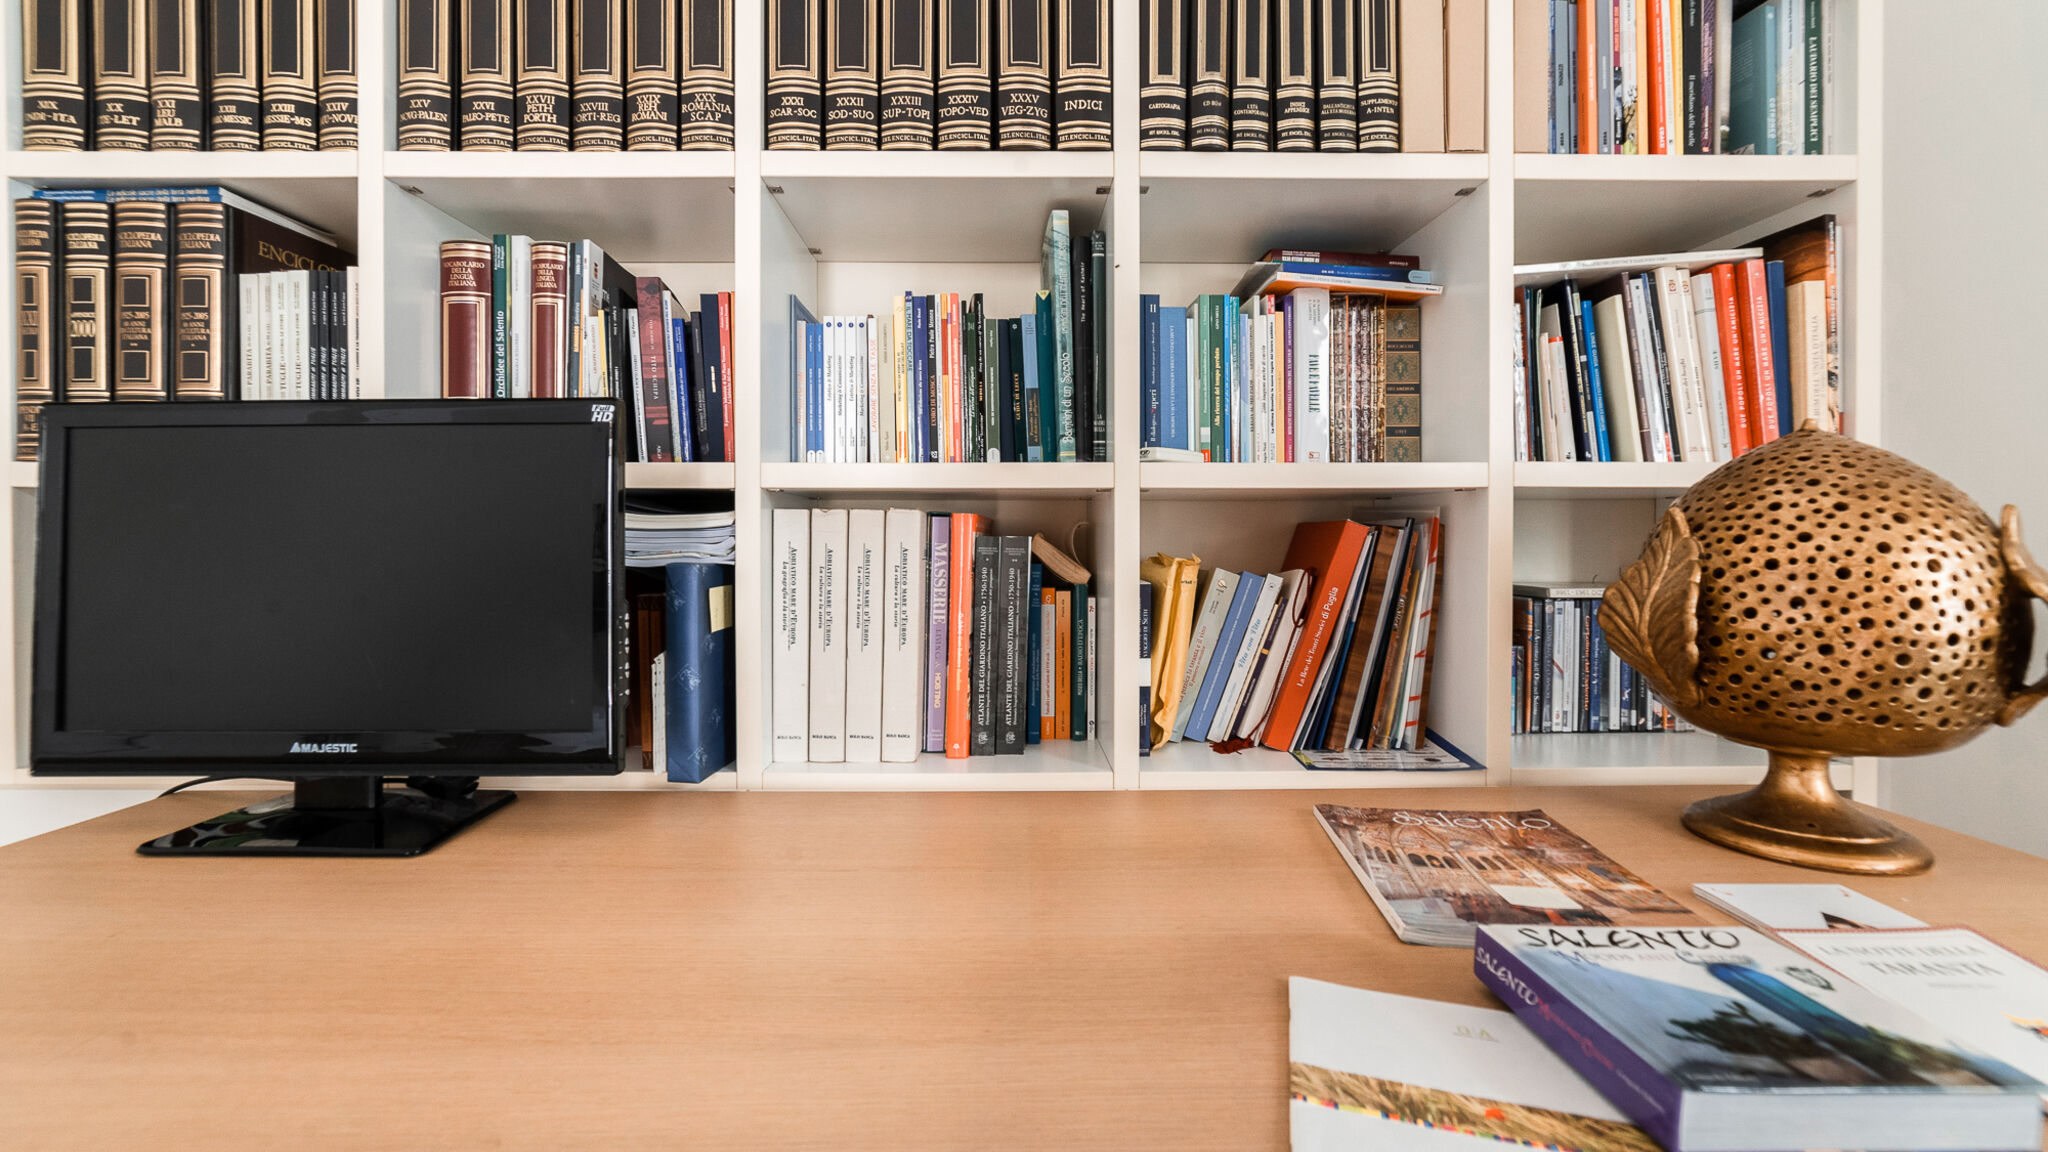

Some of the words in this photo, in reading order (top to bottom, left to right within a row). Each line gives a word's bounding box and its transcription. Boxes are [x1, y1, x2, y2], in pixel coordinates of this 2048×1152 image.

[1809, 36, 1818, 82] LAUDARIO
[1688, 81, 1696, 108] meridiano
[1809, 83, 1818, 99] DEI
[410, 99, 431, 108] XXV
[525, 95, 555, 105] XXVII
[636, 94, 661, 104] XXIX
[694, 93, 716, 103] XXX
[781, 96, 804, 106] XXXI
[836, 97, 864, 107] XXXII
[890, 95, 922, 106] XXXIII
[947, 94, 979, 105] XXXIV
[1010, 93, 1040, 103] XXXV
[270, 103, 295, 113] XXIII
[325, 102, 349, 112] XXIV
[472, 101, 496, 111] XXVI
[526, 104, 553, 113] PETH
[580, 102, 609, 112] XXVIII
[638, 103, 658, 112] REH
[681, 102, 733, 115] ROMANIA
[939, 105, 989, 118] TOPO-VED
[1001, 105, 1049, 118] VEG-ZYG
[1064, 100, 1103, 111] INDICI
[523, 113, 557, 123] PORTH
[631, 111, 668, 122] ROMANI
[690, 111, 722, 121] SCAP
[769, 107, 817, 119] SCAR-SOC
[828, 109, 874, 120] SOD-SUO
[882, 107, 931, 120] SUP-TOPI
[1688, 112, 1696, 129] delle
[1810, 99, 1818, 142] SEMPLICI
[1688, 130, 1696, 147] stelle
[448, 279, 477, 287] ITALIANA
[450, 273, 475, 281] LINGUA
[496, 310, 505, 342] Salento
[1728, 297, 1738, 344] UN'AMICIZIA
[1757, 296, 1767, 343] UN'AMICIZIA
[905, 331, 912, 340] DA
[496, 344, 505, 355] del
[1214, 347, 1222, 368] perduto
[1733, 347, 1741, 366] MARE
[1761, 347, 1769, 366] MARE
[650, 355, 658, 373] TITO
[1060, 352, 1072, 384] Secolo
[496, 357, 505, 398] Orchidee
[1214, 370, 1222, 386] tempo
[1735, 370, 1742, 380] UN
[1763, 370, 1771, 380] UN
[651, 374, 659, 400] SCHIPA
[1062, 386, 1072, 397] un
[930, 398, 936, 407] DI
[1061, 399, 1072, 407] di
[1737, 383, 1745, 410] POPOLI
[1765, 383, 1773, 411] POPOLI
[591, 411, 614, 422] HD
[1062, 409, 1074, 443] Bambini
[782, 561, 788, 569] La
[790, 547, 798, 586] ADRIATICO
[826, 548, 834, 587] ADRIATICO
[864, 548, 872, 587] ADRIATICO
[932, 542, 948, 624] MASSERIE
[1008, 567, 1016, 600] 1750-1940
[1322, 587, 1339, 611] Puglia
[1320, 611, 1329, 619] di
[979, 605, 987, 639] ITALIANO
[1314, 619, 1326, 637] Storici
[825, 611, 833, 647] D'EUROPA
[863, 611, 871, 647] D'EUROPA
[935, 628, 943, 659] LIVING
[1308, 638, 1319, 654] Teatri
[1006, 640, 1014, 677] GIARDINO
[1304, 655, 1313, 665] dei
[1296, 679, 1304, 687] La
[933, 672, 942, 709] HOSTING
[978, 695, 986, 726] ATLANTE
[1005, 695, 1013, 726] ATLANTE
[301, 743, 358, 753] MAJESTIC
[1392, 811, 1552, 831] Salento
[1518, 927, 1741, 950] SALENTO
[1475, 947, 1538, 1006] SALENTO
